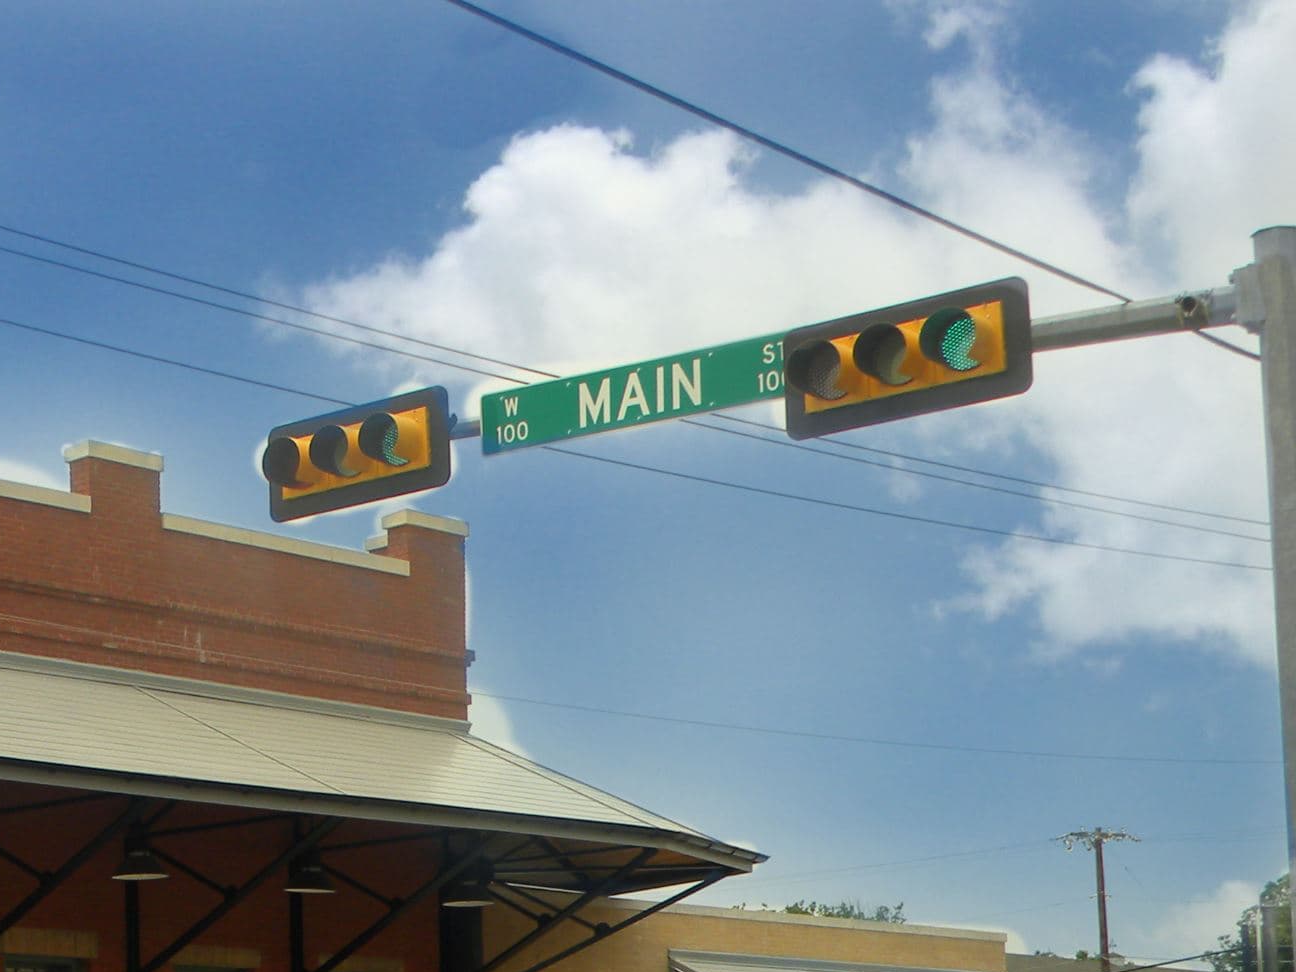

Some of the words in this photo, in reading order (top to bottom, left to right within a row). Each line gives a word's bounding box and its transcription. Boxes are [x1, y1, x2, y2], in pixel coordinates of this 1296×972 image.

[757, 370, 785, 393] 10
[578, 358, 702, 429] MAIN
[504, 396, 519, 417] W
[496, 421, 529, 445] 100
